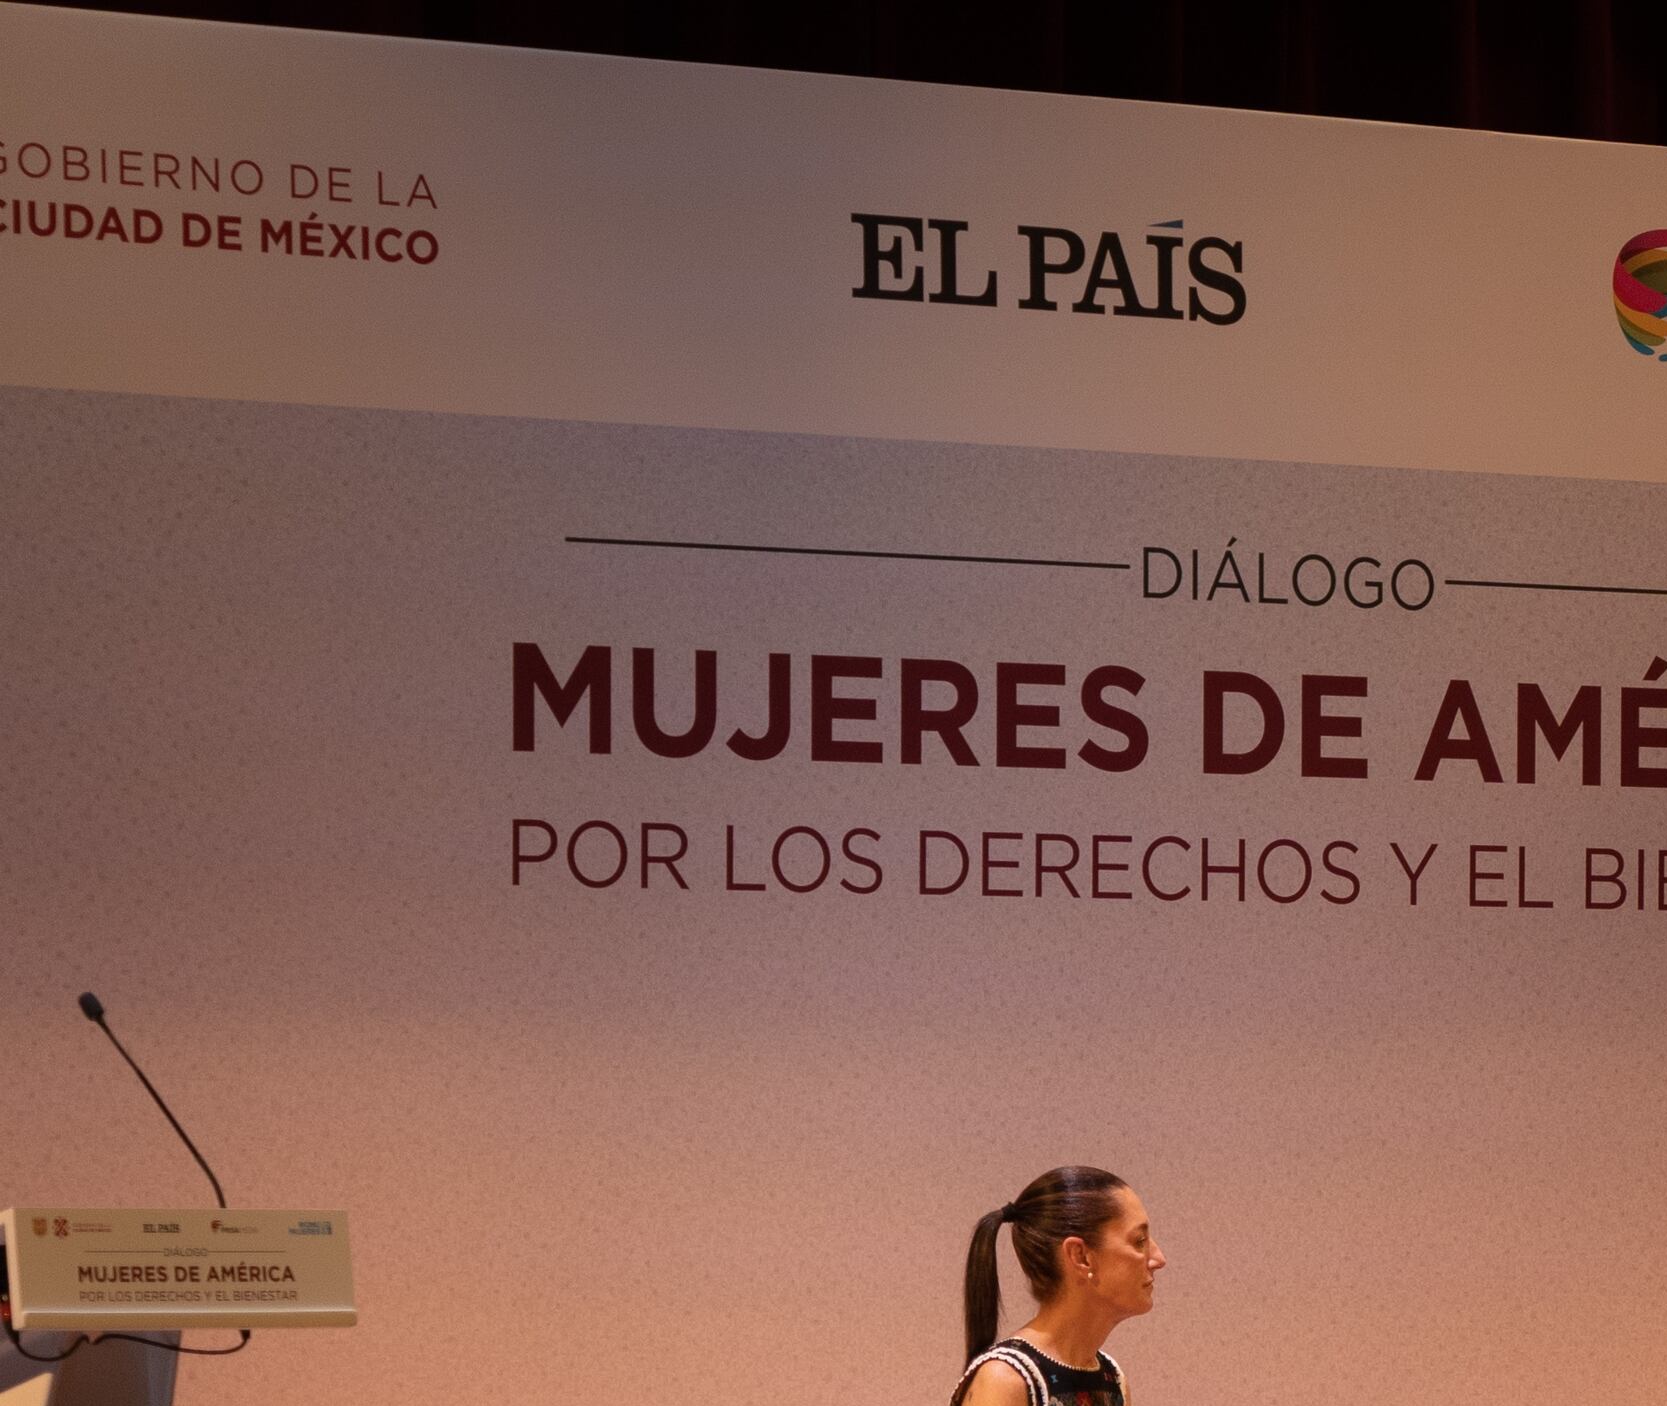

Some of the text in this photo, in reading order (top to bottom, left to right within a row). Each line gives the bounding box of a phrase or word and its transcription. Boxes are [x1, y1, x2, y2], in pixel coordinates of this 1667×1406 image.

[0, 142, 437, 209] OBIERNO DE LA
[0, 199, 438, 264] IUDAD DE MÉXICO
[851, 213, 1246, 325] EL PAÍS
[1142, 537, 1435, 611] DIÁLOGO
[513, 642, 1148, 772] MUJERES
[1203, 671, 1368, 778] DE
[512, 819, 688, 889] POR
[726, 825, 882, 894] LOS
[919, 830, 1360, 904] DERECHOS
[1390, 843, 1437, 905] Y
[1470, 845, 1553, 908] EL
[78, 1262, 295, 1283] MUJERES DE AMÉRICA
[163, 1247, 208, 1257] DIÁLOGO
[79, 1290, 298, 1302] POR LOS DERECHOS Y EL BIENESTAR
